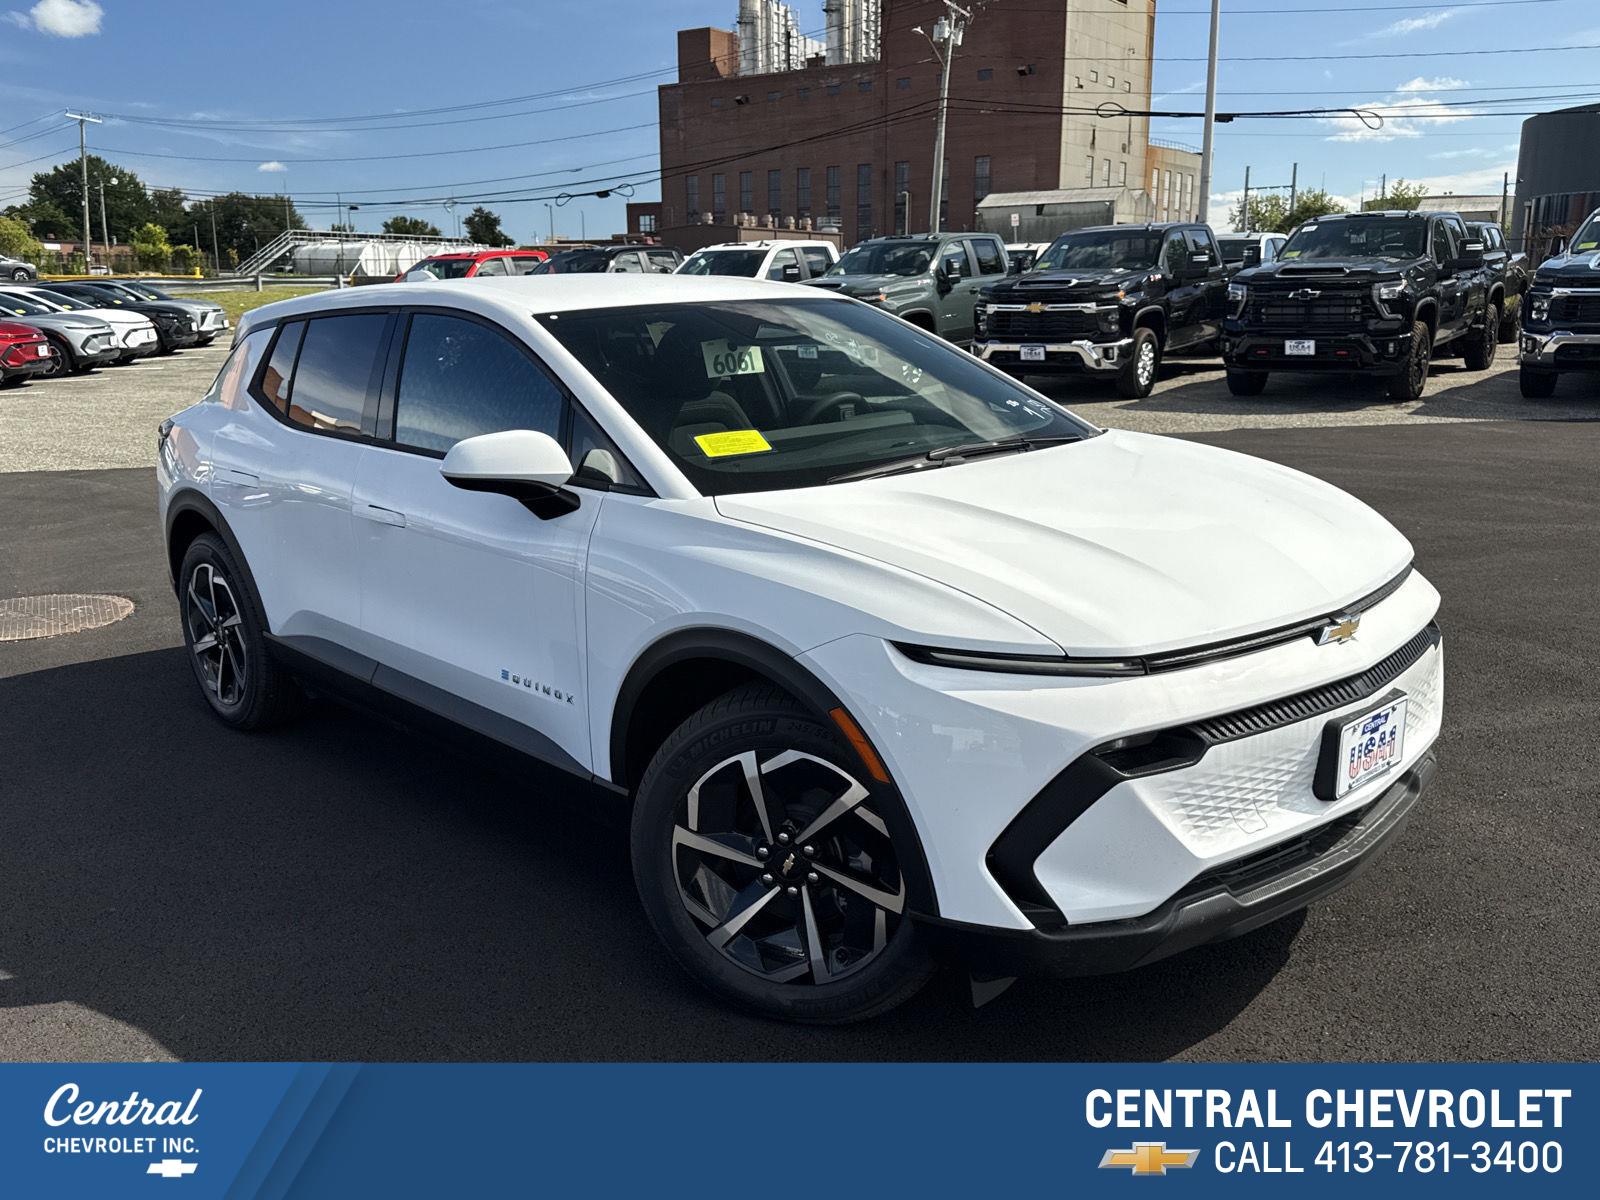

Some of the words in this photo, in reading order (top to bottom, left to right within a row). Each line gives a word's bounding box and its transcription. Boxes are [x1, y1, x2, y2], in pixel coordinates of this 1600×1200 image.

[713, 351, 755, 375] 6061
[501, 669, 574, 705] EQUINOX
[690, 719, 772, 757] MICHELIN
[1364, 715, 1386, 733] CENTRAL
